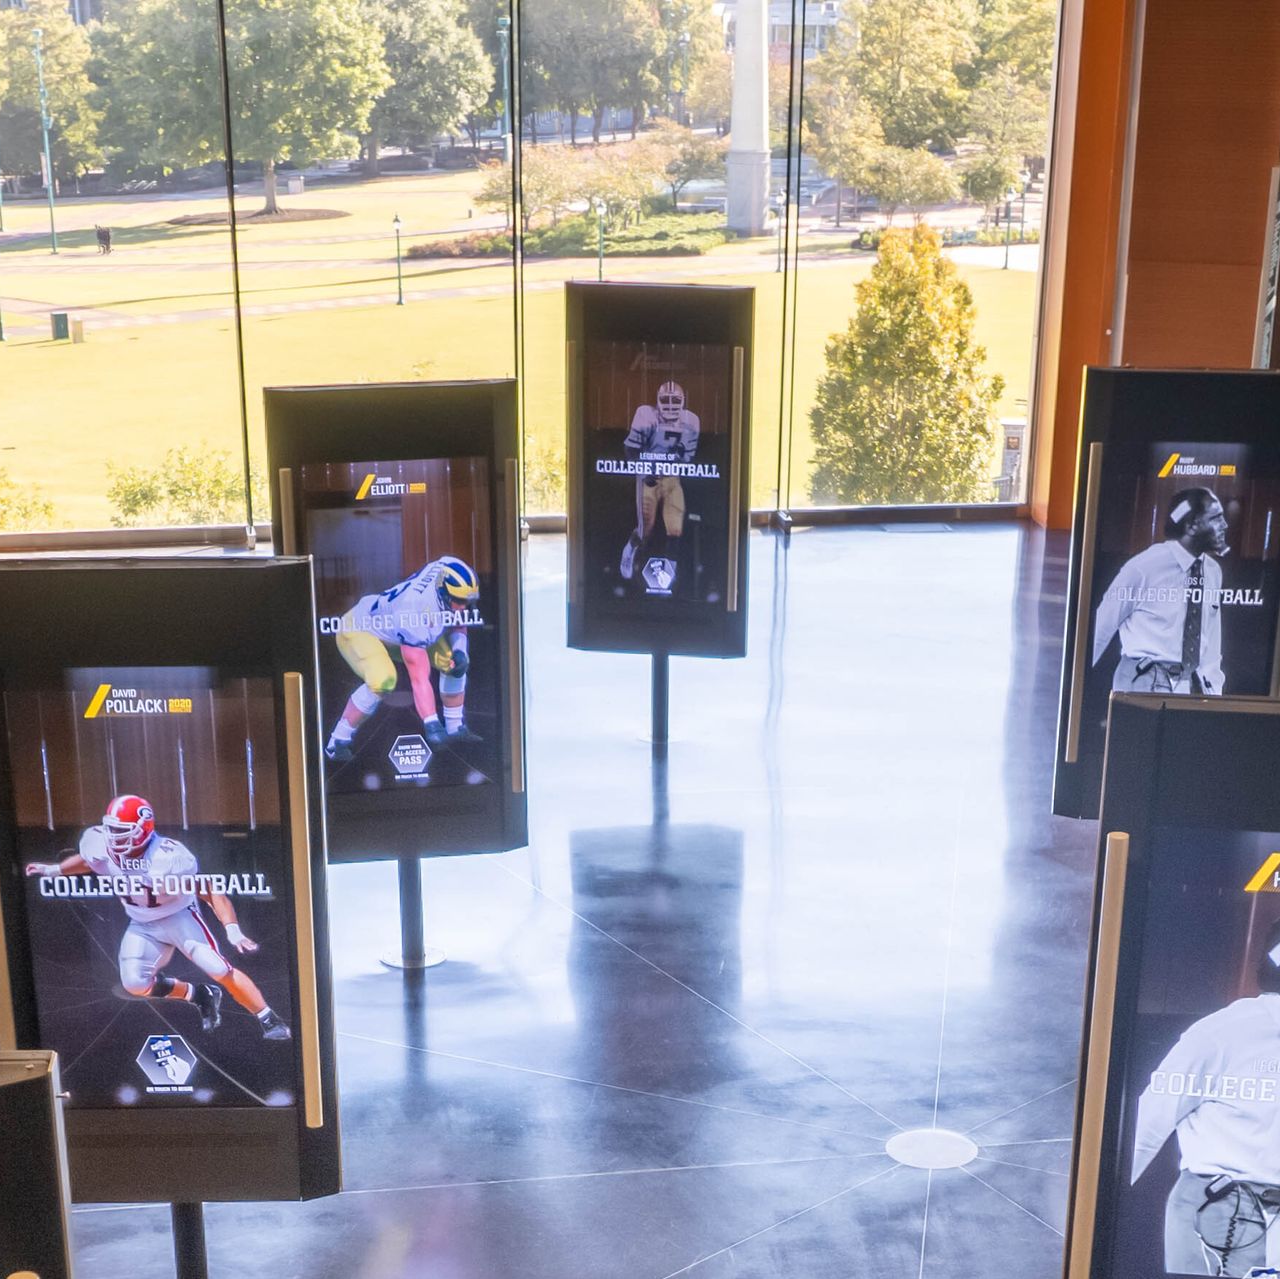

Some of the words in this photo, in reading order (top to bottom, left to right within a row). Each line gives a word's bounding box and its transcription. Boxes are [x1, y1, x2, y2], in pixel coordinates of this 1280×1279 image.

[596, 460, 652, 474] COLLEGE
[655, 462, 720, 478] FOOTBALL
[1173, 465, 1216, 475] HUBBARD
[371, 484, 405, 495] ELLIOTT
[1184, 588, 1263, 605] FOOTBALL
[320, 615, 394, 634] COLLEGE
[400, 609, 484, 628] FOOTBALL
[112, 689, 136, 698] DAVID
[105, 699, 163, 713] POLLACK
[400, 756, 422, 765] PASS
[40, 876, 143, 897] COLLEGE
[152, 874, 270, 896] FOOTBALL
[1150, 1071, 1276, 1102] COLLEGE
